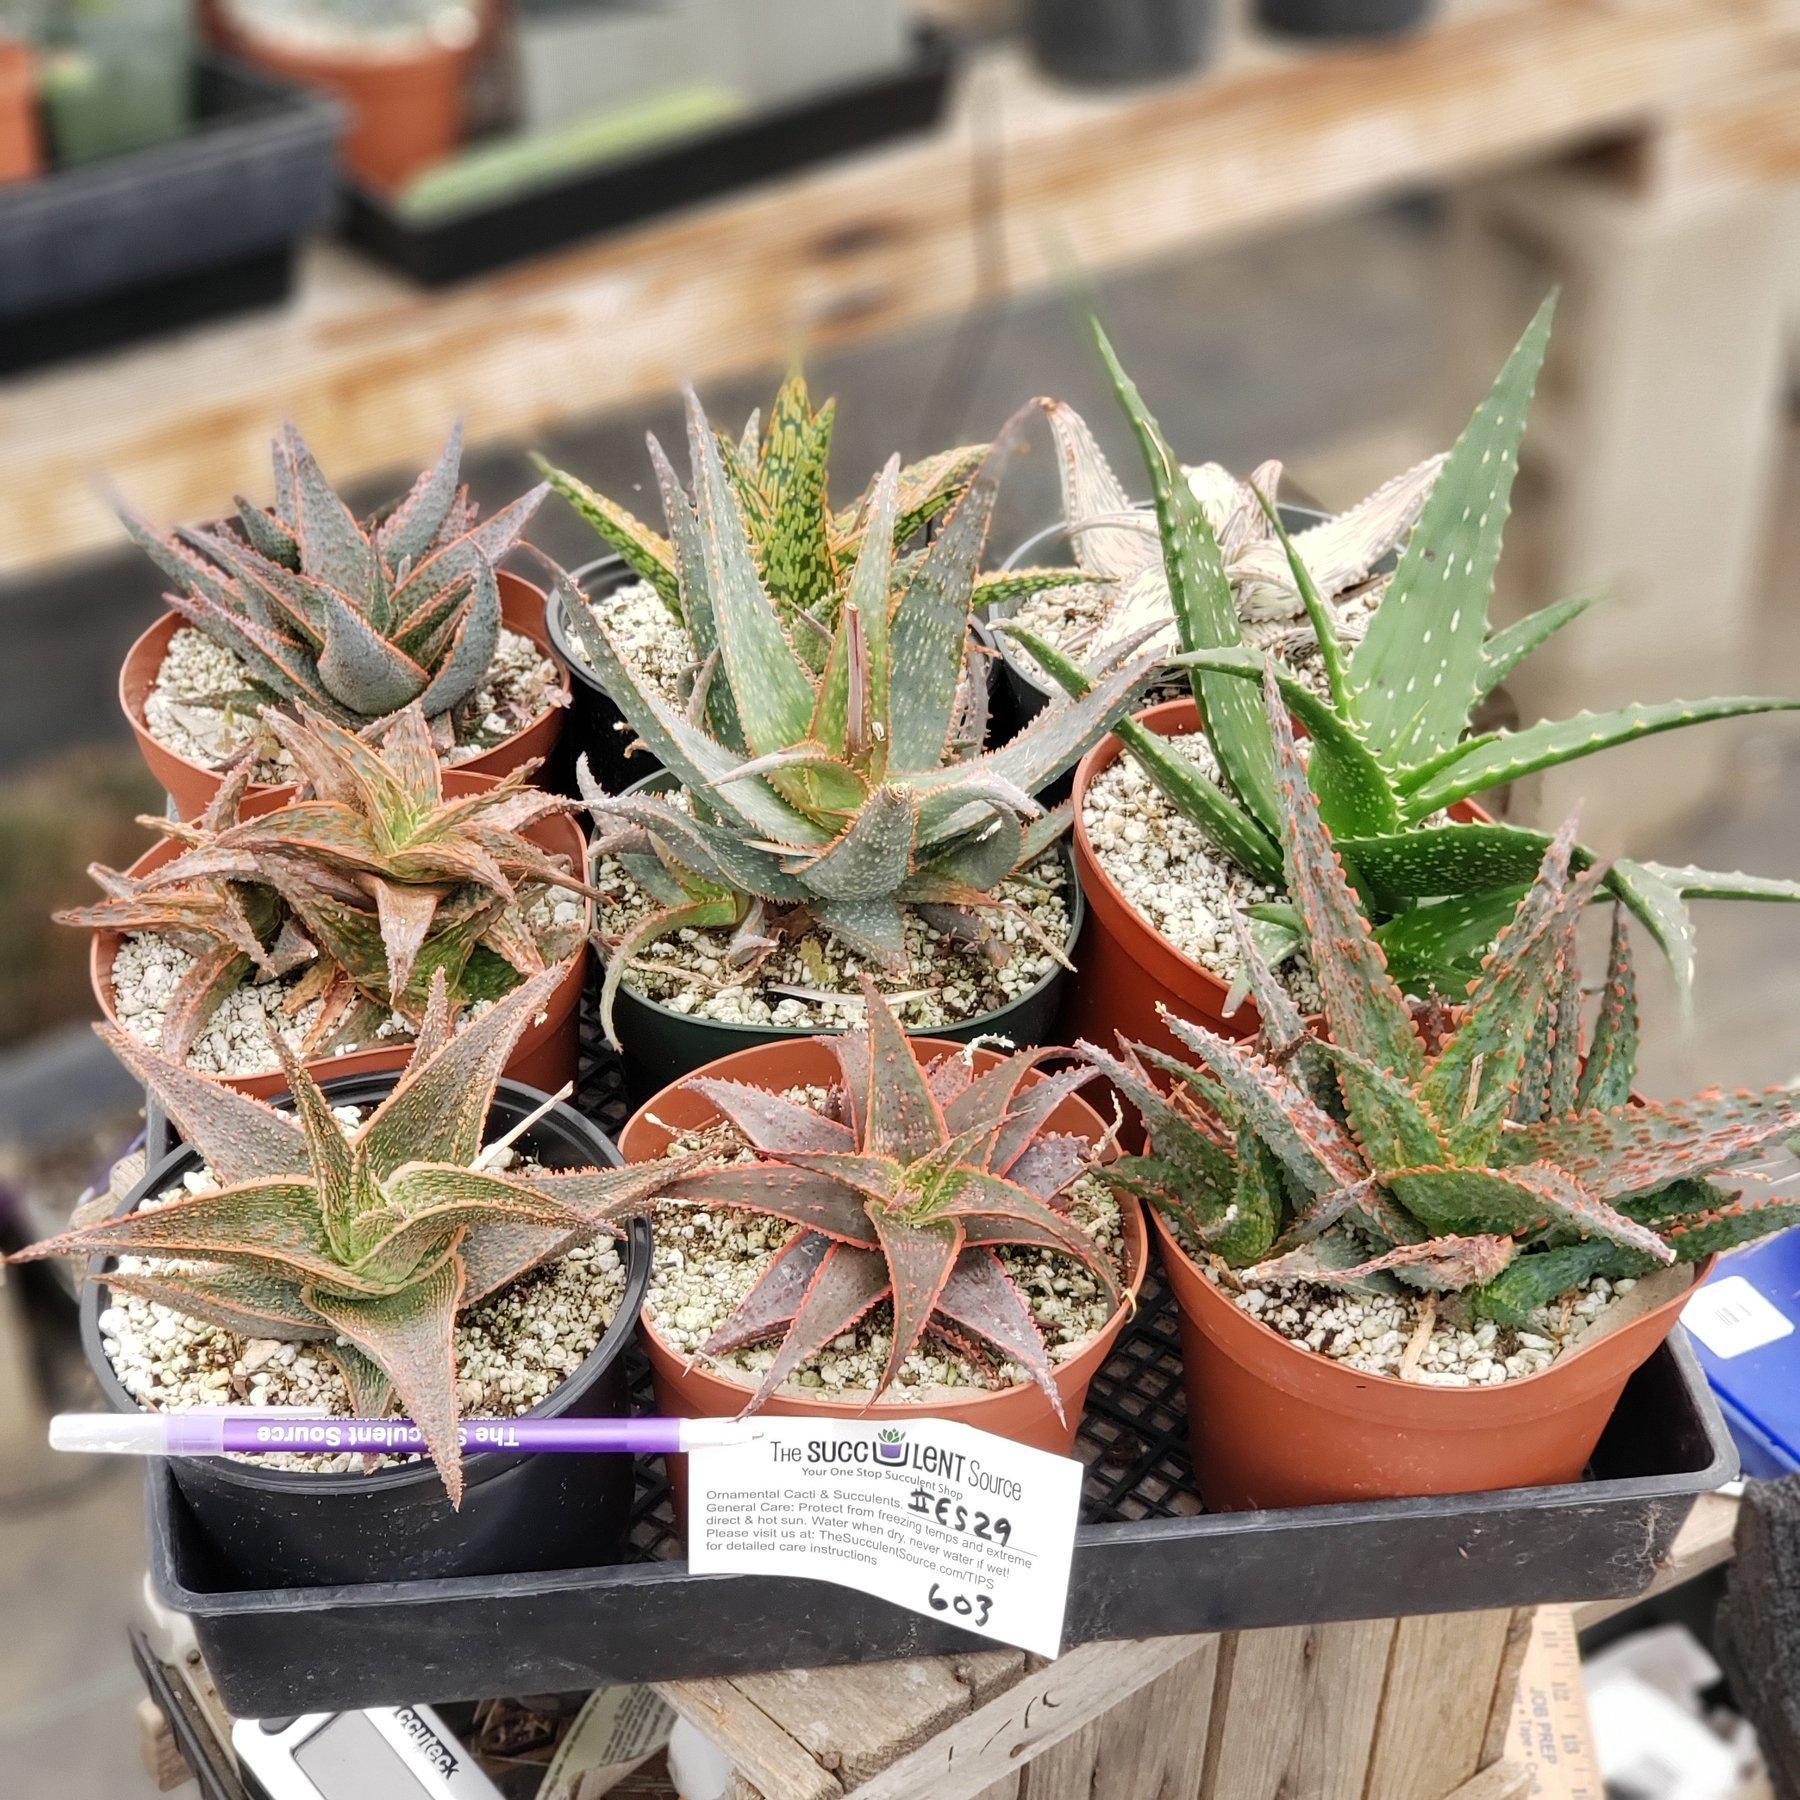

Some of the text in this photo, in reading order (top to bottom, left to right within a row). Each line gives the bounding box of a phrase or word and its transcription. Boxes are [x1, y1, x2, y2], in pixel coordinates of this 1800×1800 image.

[256, 1427, 520, 1447] The Sculent Source
[706, 1489, 780, 1500] Ornamental
[784, 1489, 816, 1499] Cacti
[820, 1490, 829, 1499] &
[801, 1467, 963, 1501] Your One Stop Succulent Shop
[968, 1459, 1022, 1501] Source
[706, 1502, 1032, 1569] General Care: Protect from freezing temps and extreme
[706, 1515, 741, 1525] direct
[744, 1515, 754, 1525] &
[758, 1515, 778, 1525] hot
[781, 1516, 806, 1525] sun.
[812, 1515, 849, 1528] Water
[852, 1519, 884, 1535] when
[909, 1536, 940, 1555] never
[943, 1549, 974, 1565] water
[976, 1559, 984, 1569] if
[987, 1564, 1010, 1578] wet!
[706, 1541, 877, 1566] for detailed care instructions
[706, 1528, 994, 1590] Please visit us at: TheSucculentSource.com/TIPS
[928, 1583, 993, 1627] 603
[393, 1704, 459, 1781] ccuteck
[1530, 1687, 1557, 1765] JOB PREP
